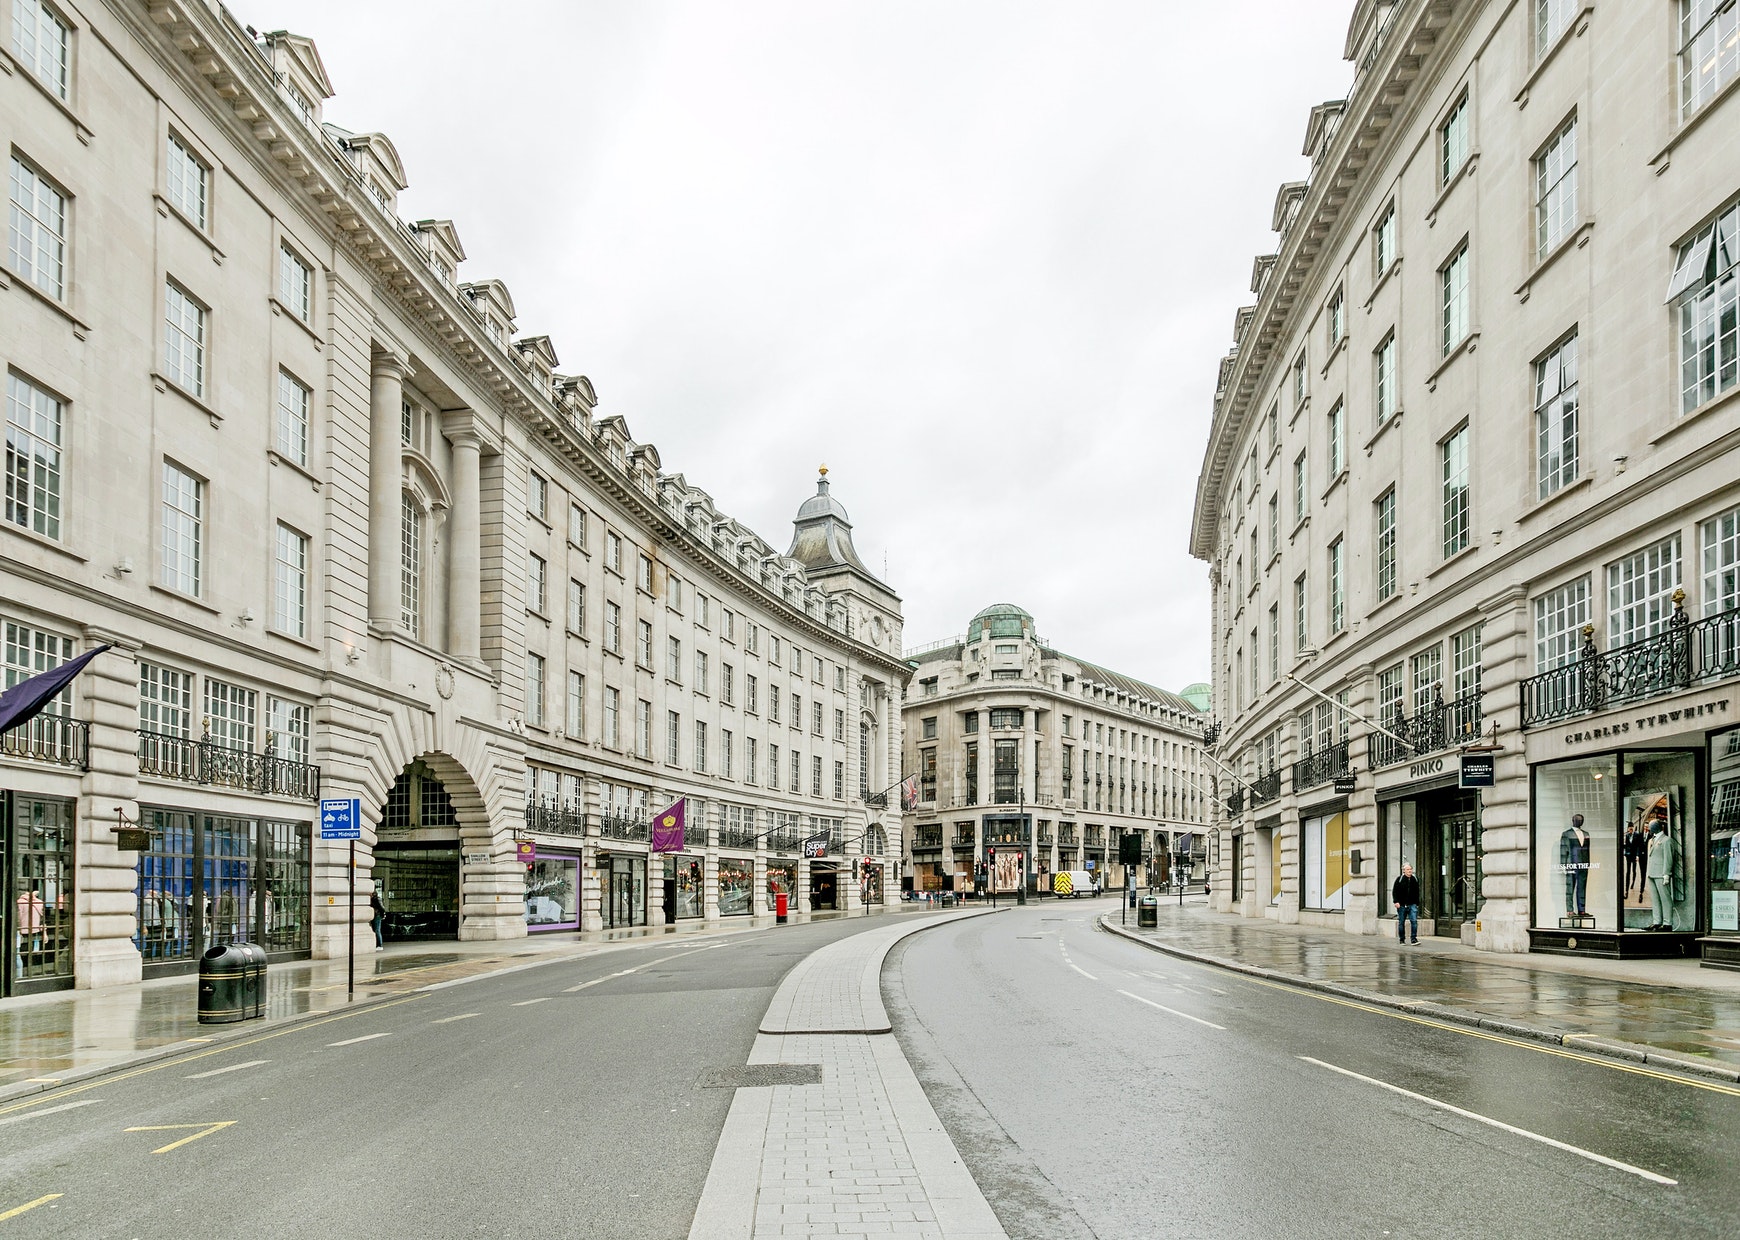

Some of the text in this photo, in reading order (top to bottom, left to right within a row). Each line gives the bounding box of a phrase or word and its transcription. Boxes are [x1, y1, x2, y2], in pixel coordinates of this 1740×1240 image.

[1565, 699, 1729, 745] CHARLES TYRWHITT
[1410, 759, 1443, 778] PINKO
[805, 847, 817, 857] Dry
[806, 841, 827, 851] Super
